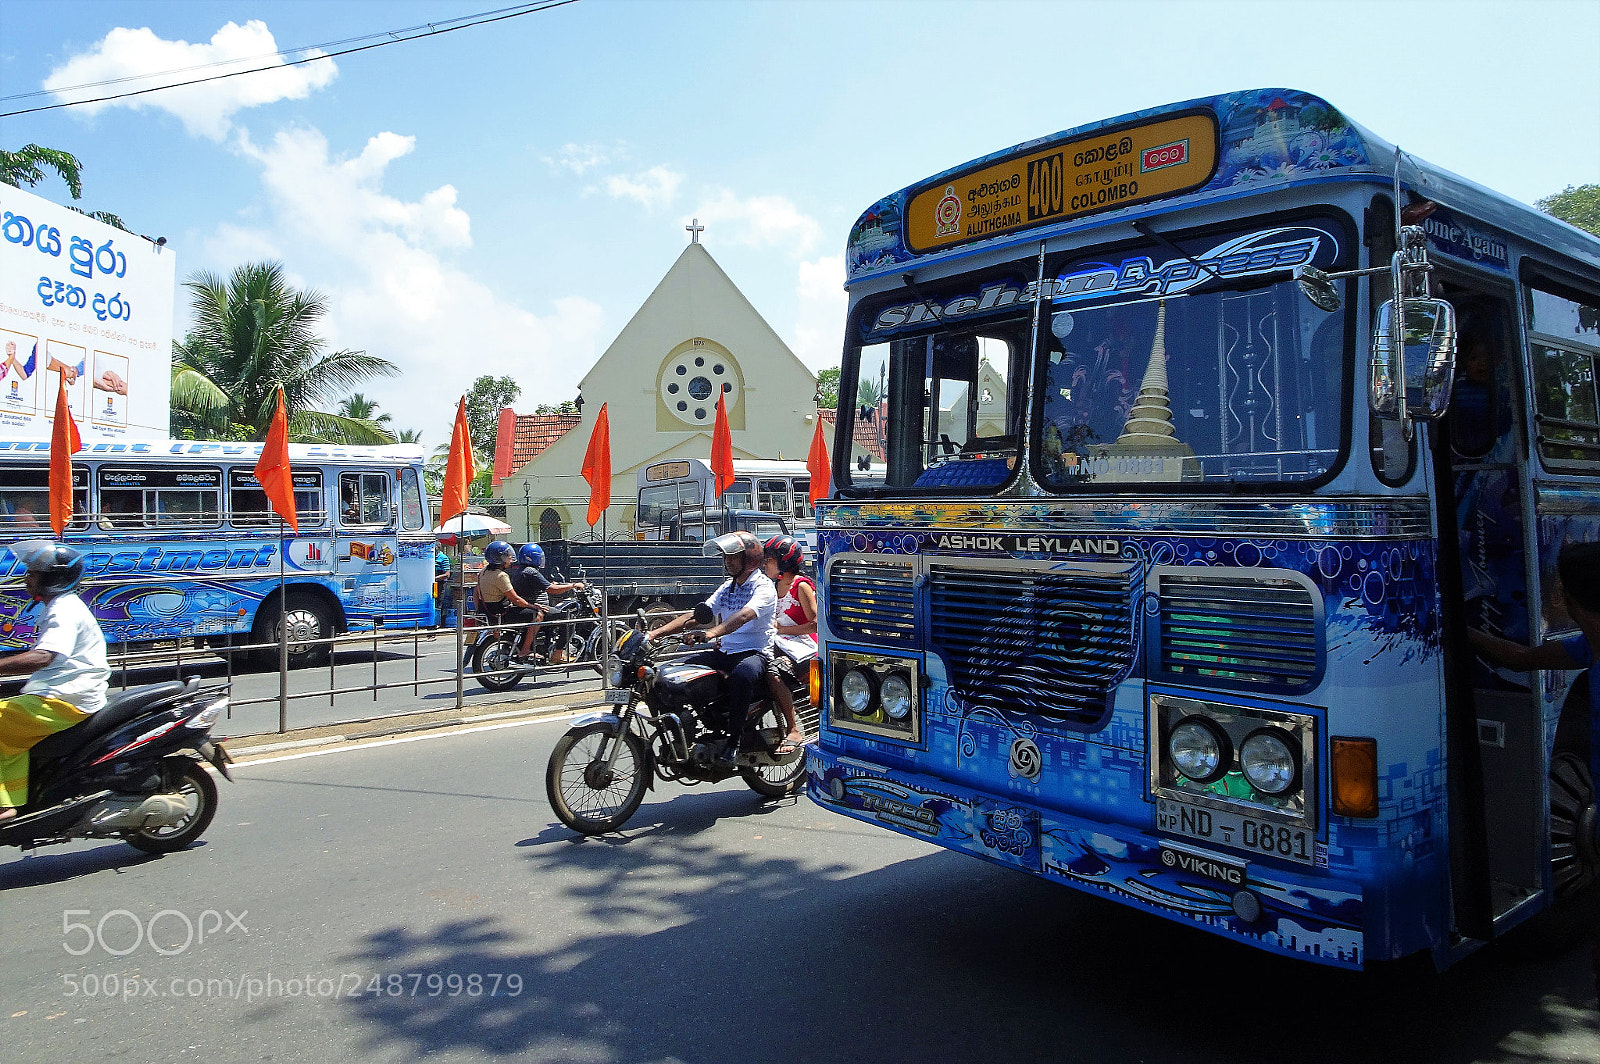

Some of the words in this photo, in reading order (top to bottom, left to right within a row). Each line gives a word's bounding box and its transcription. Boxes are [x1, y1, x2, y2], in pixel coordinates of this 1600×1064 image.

[1073, 136, 1133, 168] කොළඹ
[1028, 153, 1063, 219] 400
[1075, 161, 1133, 186] கொழும்பு
[1071, 180, 1139, 211] COLOMBO
[966, 211, 1022, 236] ALUTHGAMA
[1424, 217, 1458, 243] ome
[1460, 228, 1506, 260] Again
[0, 211, 62, 258] තය
[69, 235, 127, 279] පුරා
[37, 276, 87, 309] දෑත
[92, 292, 131, 322] දරා
[938, 534, 1005, 551] ASHOK
[1015, 537, 1120, 555] LEYLAND
[861, 791, 935, 823] TURBO
[1158, 812, 1178, 829] WP
[1180, 805, 1212, 838] ND
[1242, 819, 1312, 862] 0881
[1177, 853, 1242, 885] VIKING
